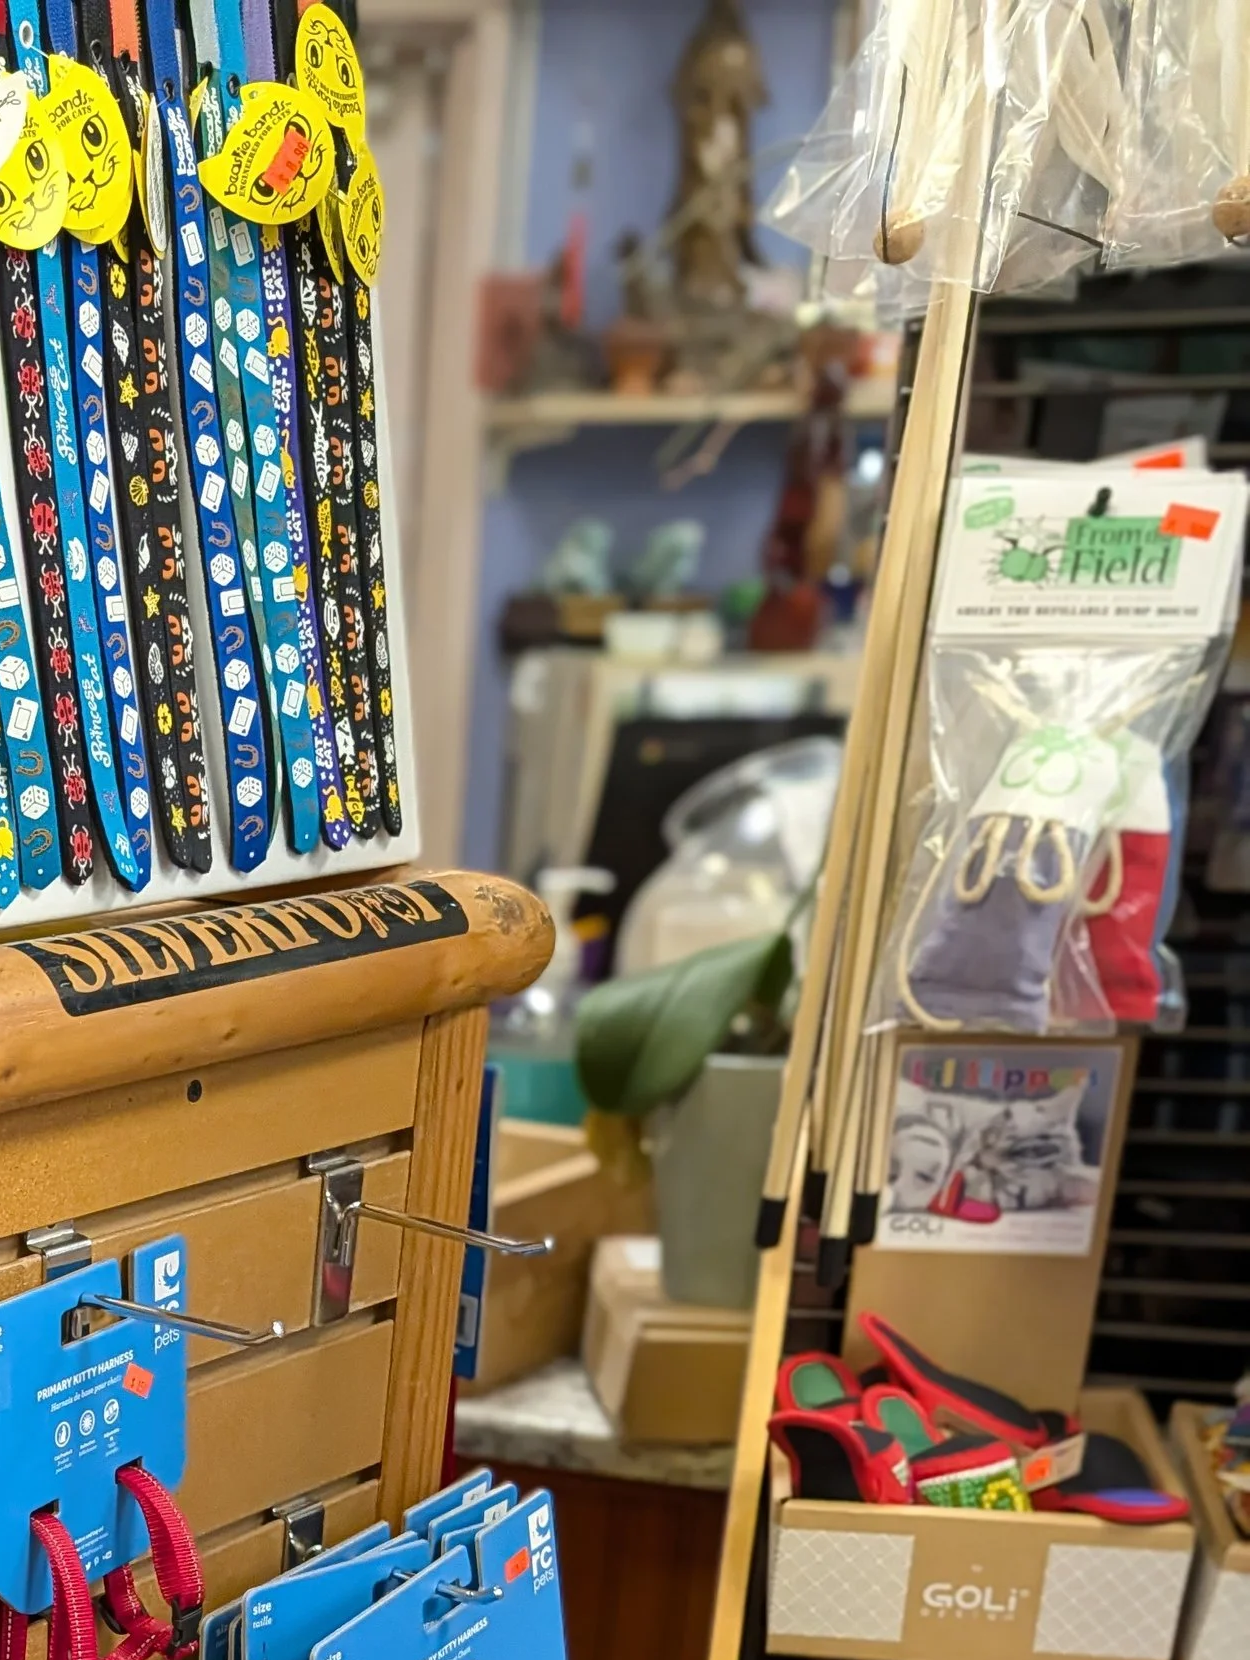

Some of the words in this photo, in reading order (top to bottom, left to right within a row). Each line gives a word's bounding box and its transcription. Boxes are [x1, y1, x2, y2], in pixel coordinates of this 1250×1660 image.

[56, 117, 72, 132] FOR
[72, 105, 92, 121] CATS
[224, 139, 251, 197] beastie
[250, 101, 285, 139] bands
[238, 138, 261, 197] ENGINEERED
[260, 121, 274, 140] FOR
[272, 108, 292, 126] CATS
[262, 266, 278, 301] FAT
[273, 266, 287, 301] CAT
[50, 338, 70, 390] Cat
[280, 377, 292, 414] CAT
[48, 365, 78, 466] Princess
[291, 509, 304, 543] CAT
[1069, 546, 1171, 586] Field
[303, 614, 316, 650] CAT
[84, 652, 106, 700] Cat
[81, 677, 112, 769] Princess
[315, 737, 327, 770] FAT
[322, 737, 334, 771] CAT
[154, 1330, 181, 1355] pets
[37, 1377, 72, 1402] PRIMARY
[73, 1367, 98, 1385] KITTY
[98, 1350, 134, 1375] HARNESS
[530, 1546, 553, 1578] rc
[533, 1568, 555, 1595] pets
[252, 1600, 272, 1617] size
[252, 1615, 273, 1629] taille
[436, 1639, 459, 1660] KITTY
[457, 1616, 488, 1647] HARNESS
